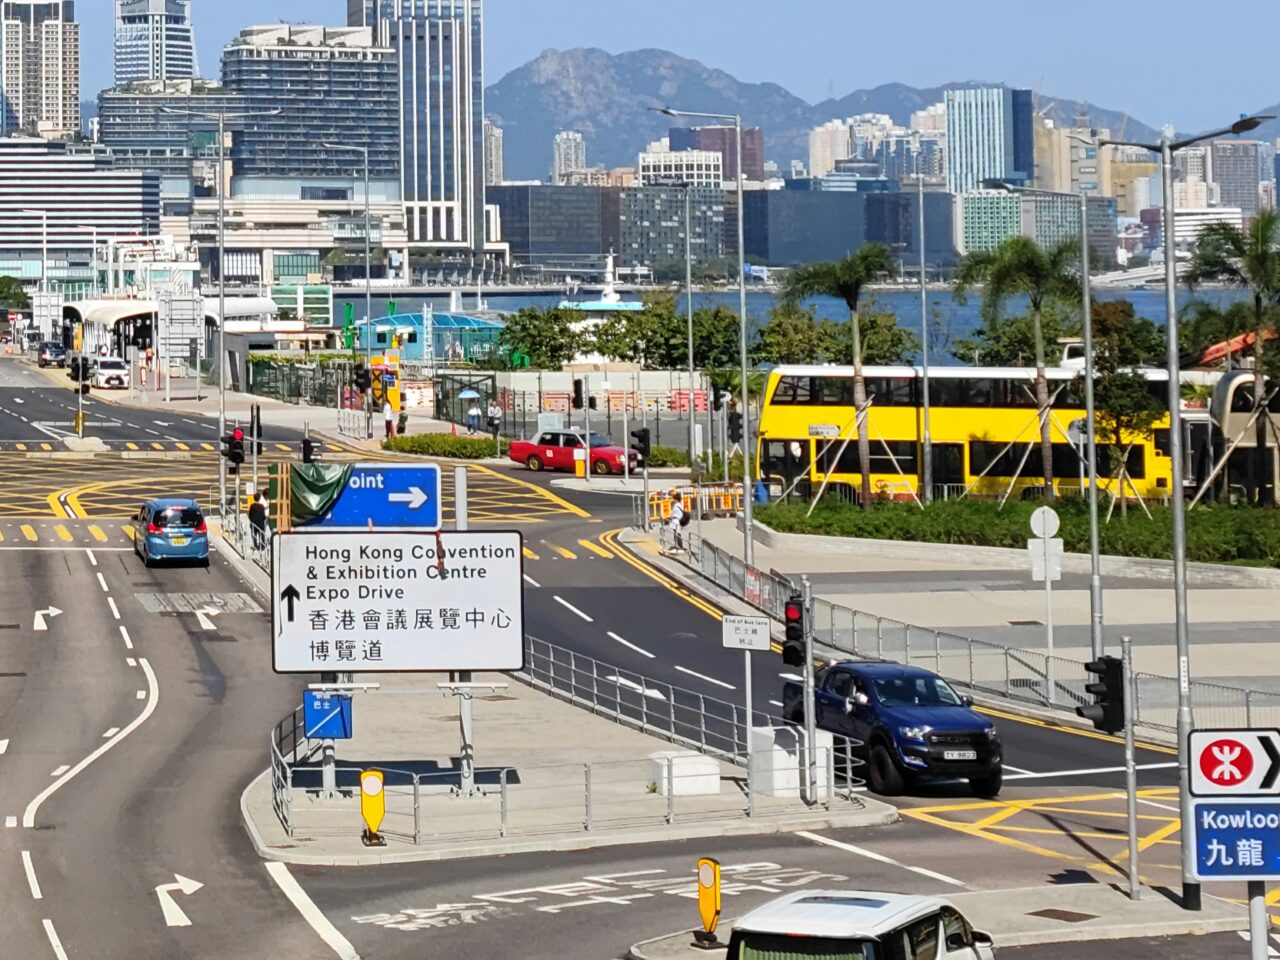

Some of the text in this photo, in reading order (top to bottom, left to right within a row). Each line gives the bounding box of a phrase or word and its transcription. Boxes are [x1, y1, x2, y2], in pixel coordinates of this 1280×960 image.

[349, 473, 384, 489] oint
[306, 545, 351, 563] Hong
[359, 545, 403, 563] Kong
[306, 566, 318, 580] &
[326, 565, 417, 580] Exhibition
[306, 585, 405, 602] Expo Drive
[309, 607, 512, 630] 香港會議展覽中心
[310, 639, 383, 661] 博覽道
[313, 700, 331, 709] 巴士
[1202, 809, 1280, 830] Kowloo
[1206, 838, 1265, 867] 九龍
